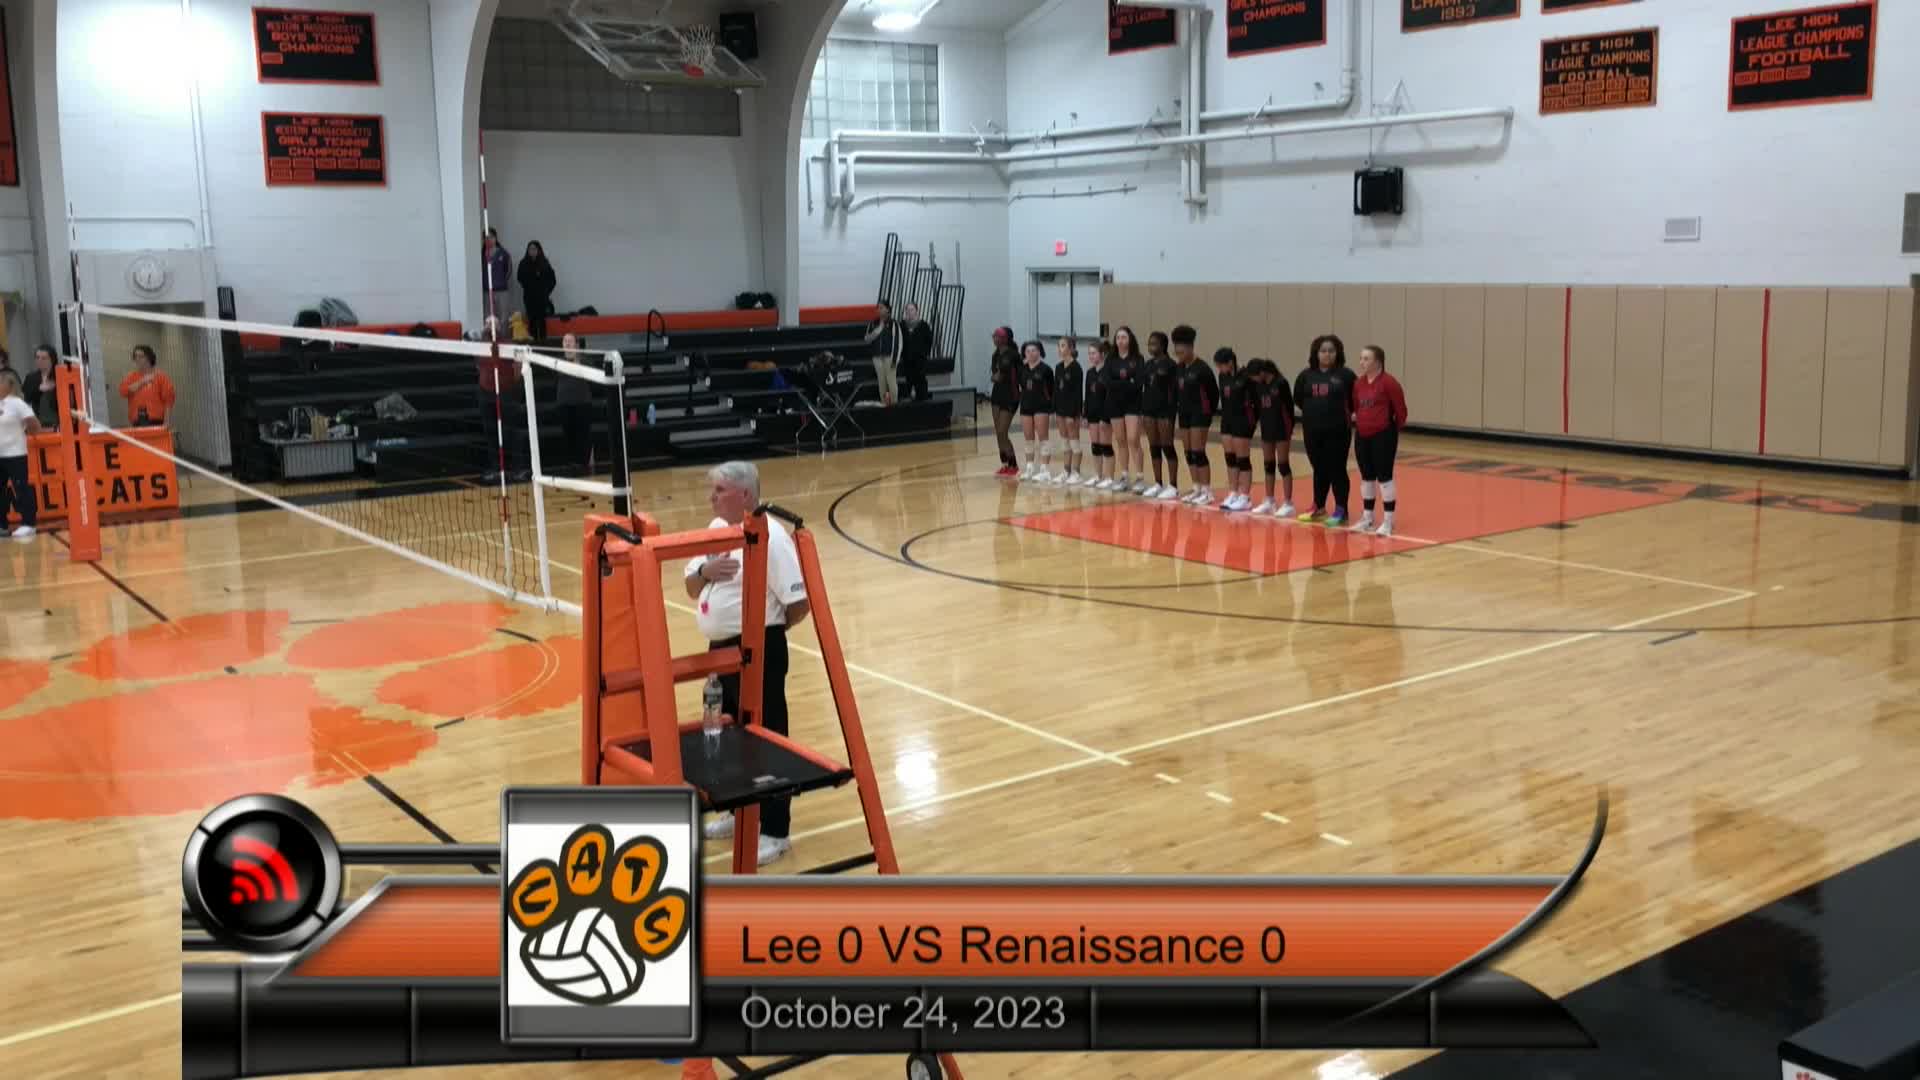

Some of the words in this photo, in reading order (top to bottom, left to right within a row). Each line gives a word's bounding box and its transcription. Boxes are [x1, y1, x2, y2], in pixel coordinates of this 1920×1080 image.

[1243, 1, 1306, 21] CHAMPIONS
[1764, 17, 1796, 33] LEE
[1802, 12, 1840, 27] HIGH
[280, 42, 354, 54] CHAMPIONS
[1561, 41, 1591, 54] LEE
[1600, 37, 1634, 50] HIGH
[1740, 33, 1788, 53] LEAGUE
[1793, 24, 1864, 46] CHAMPIONS
[1544, 55, 1585, 72] LEAGUE
[1590, 49, 1650, 67] CHAMPIONS
[1748, 43, 1852, 69] FOOTBALL
[1559, 66, 1634, 83] FOOTBALL
[288, 147, 361, 158] CHAMPIONS
[39, 442, 121, 475] LE
